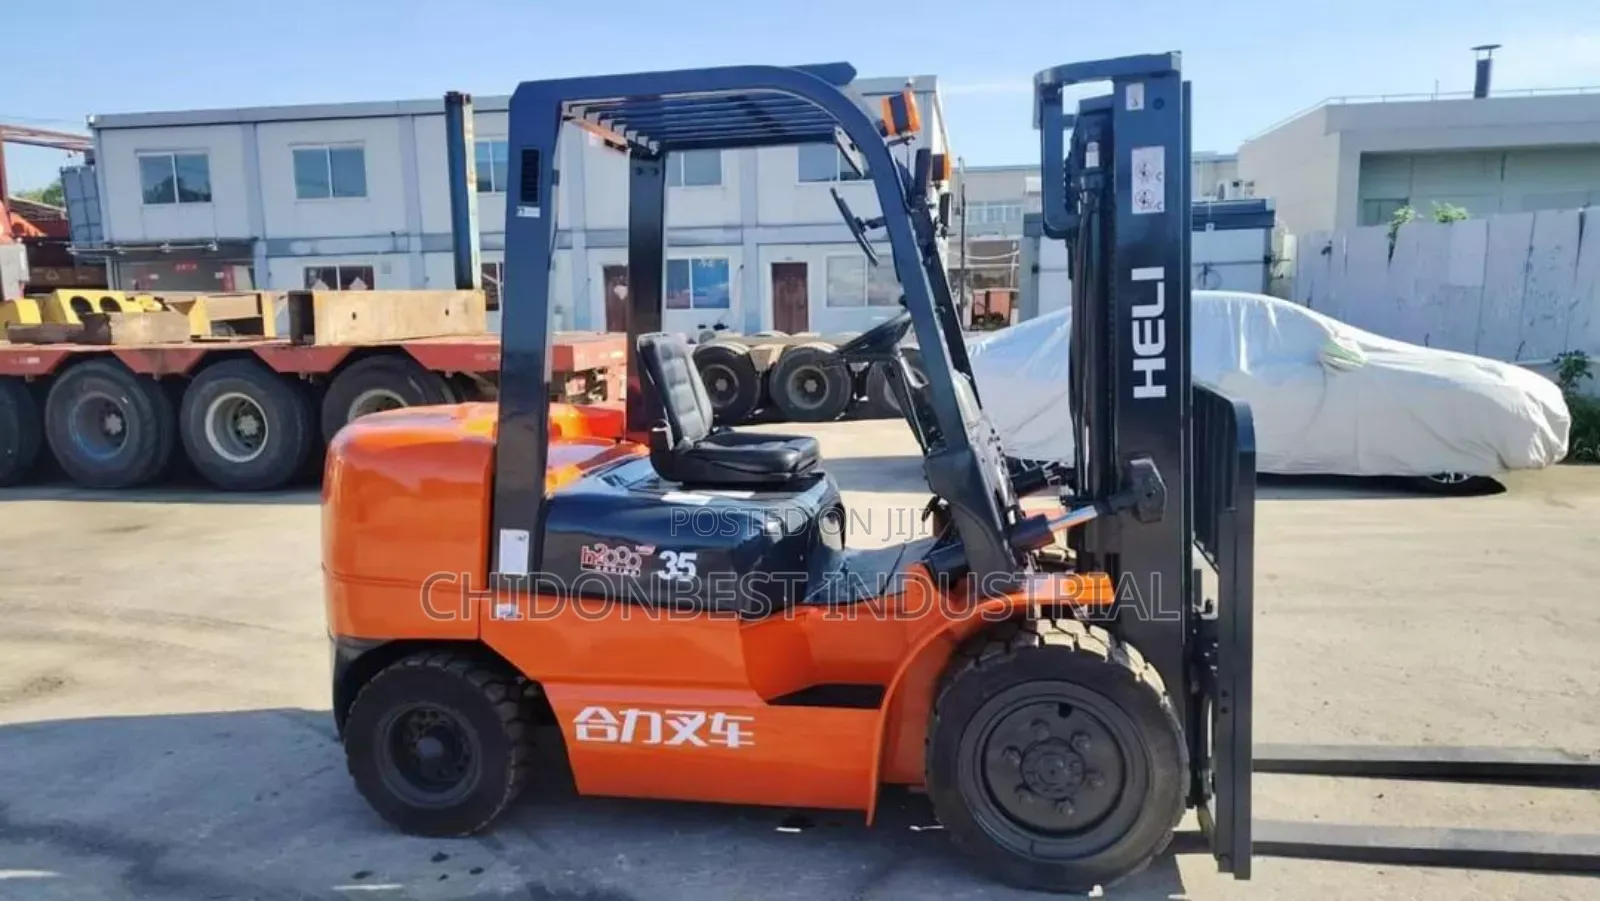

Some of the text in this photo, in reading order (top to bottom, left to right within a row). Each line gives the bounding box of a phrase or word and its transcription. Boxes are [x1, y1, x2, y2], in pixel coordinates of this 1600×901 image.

[1131, 266, 1167, 399] HELI
[658, 550, 698, 582] 35
[572, 706, 755, 749] 合力叉车
